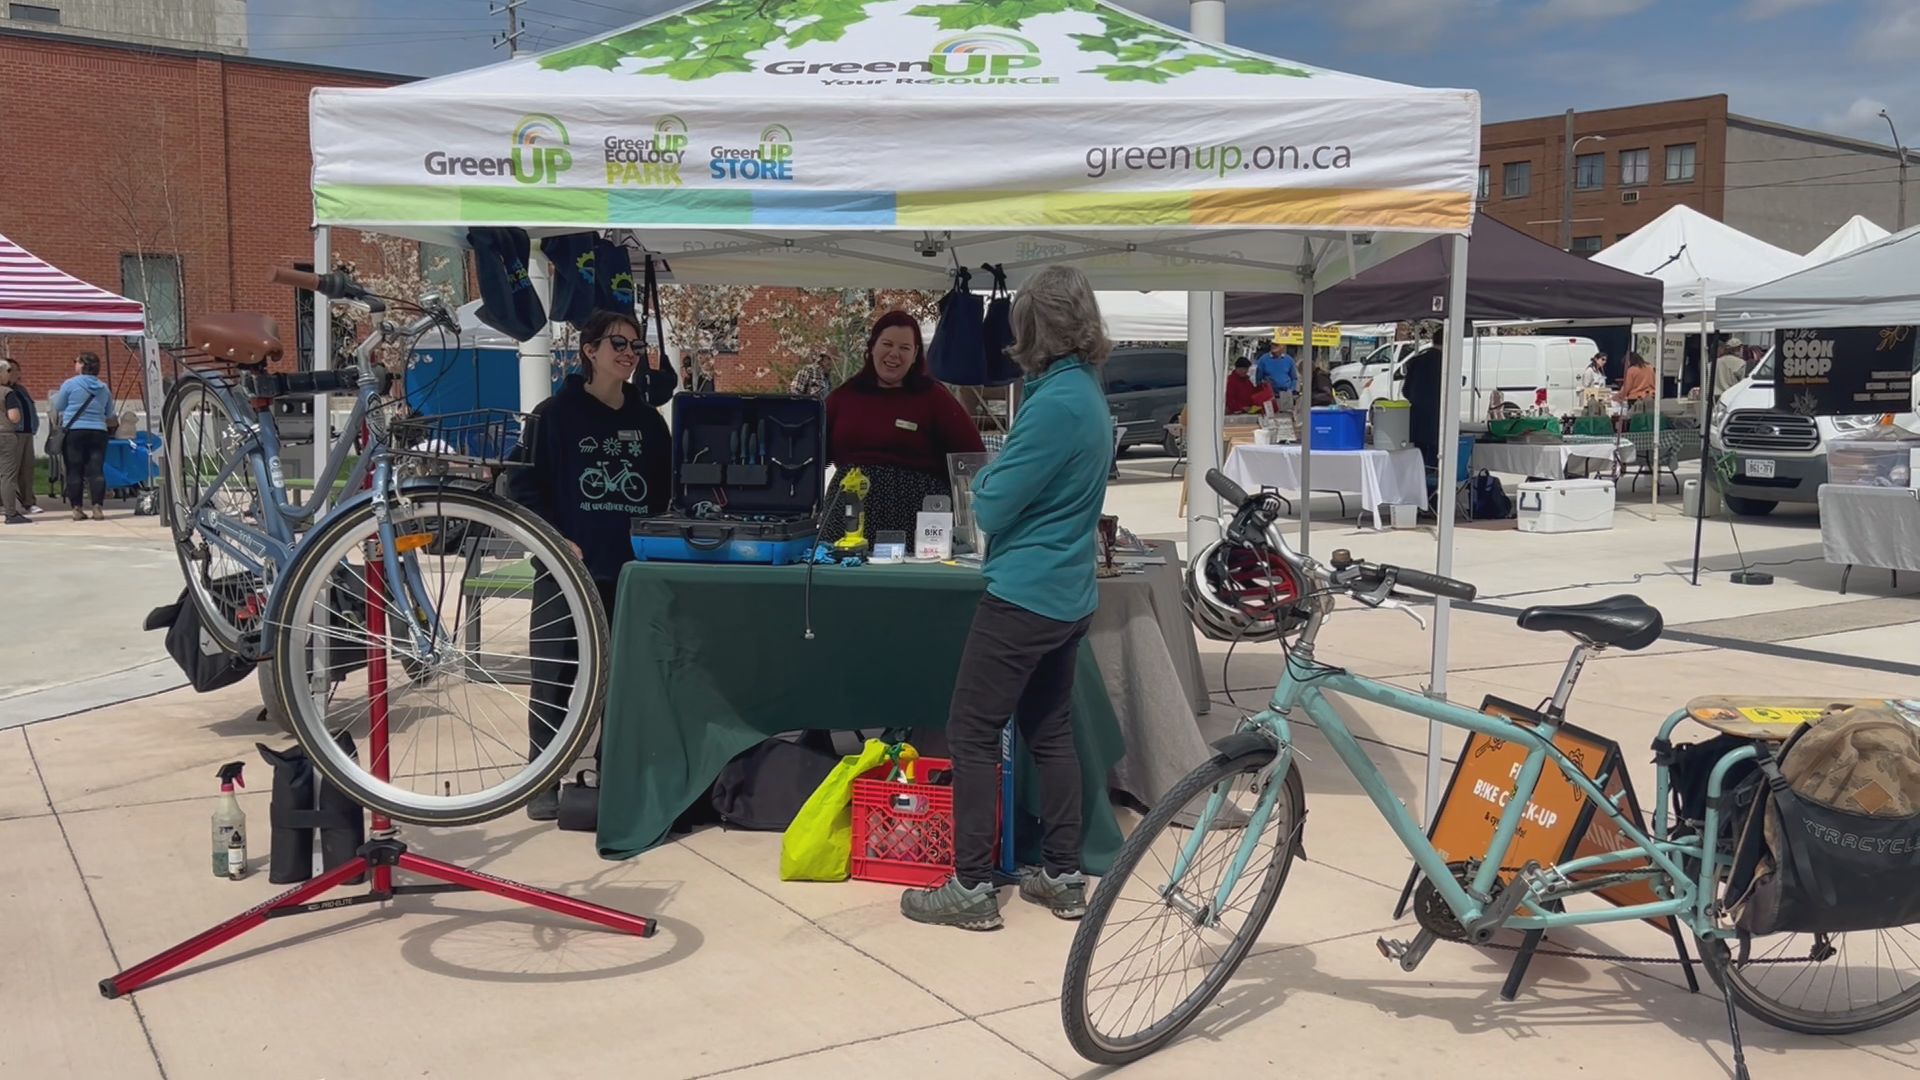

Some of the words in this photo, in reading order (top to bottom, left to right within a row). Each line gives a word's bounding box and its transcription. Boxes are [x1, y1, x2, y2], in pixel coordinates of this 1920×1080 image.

[763, 53, 1043, 77] GreenUP
[820, 78, 888, 86] Your
[604, 134, 689, 151] GreenUP
[710, 143, 793, 161] GreenUP
[424, 147, 573, 185] GreenUP
[605, 149, 686, 164] ECOLOGY
[1085, 145, 1352, 178] greenup.on.ca
[606, 162, 684, 186] PARK
[709, 159, 794, 181] STORE
[1782, 339, 1835, 358] COOK
[1783, 358, 1832, 377] SHOP
[1499, 791, 1558, 829] CK-UP
